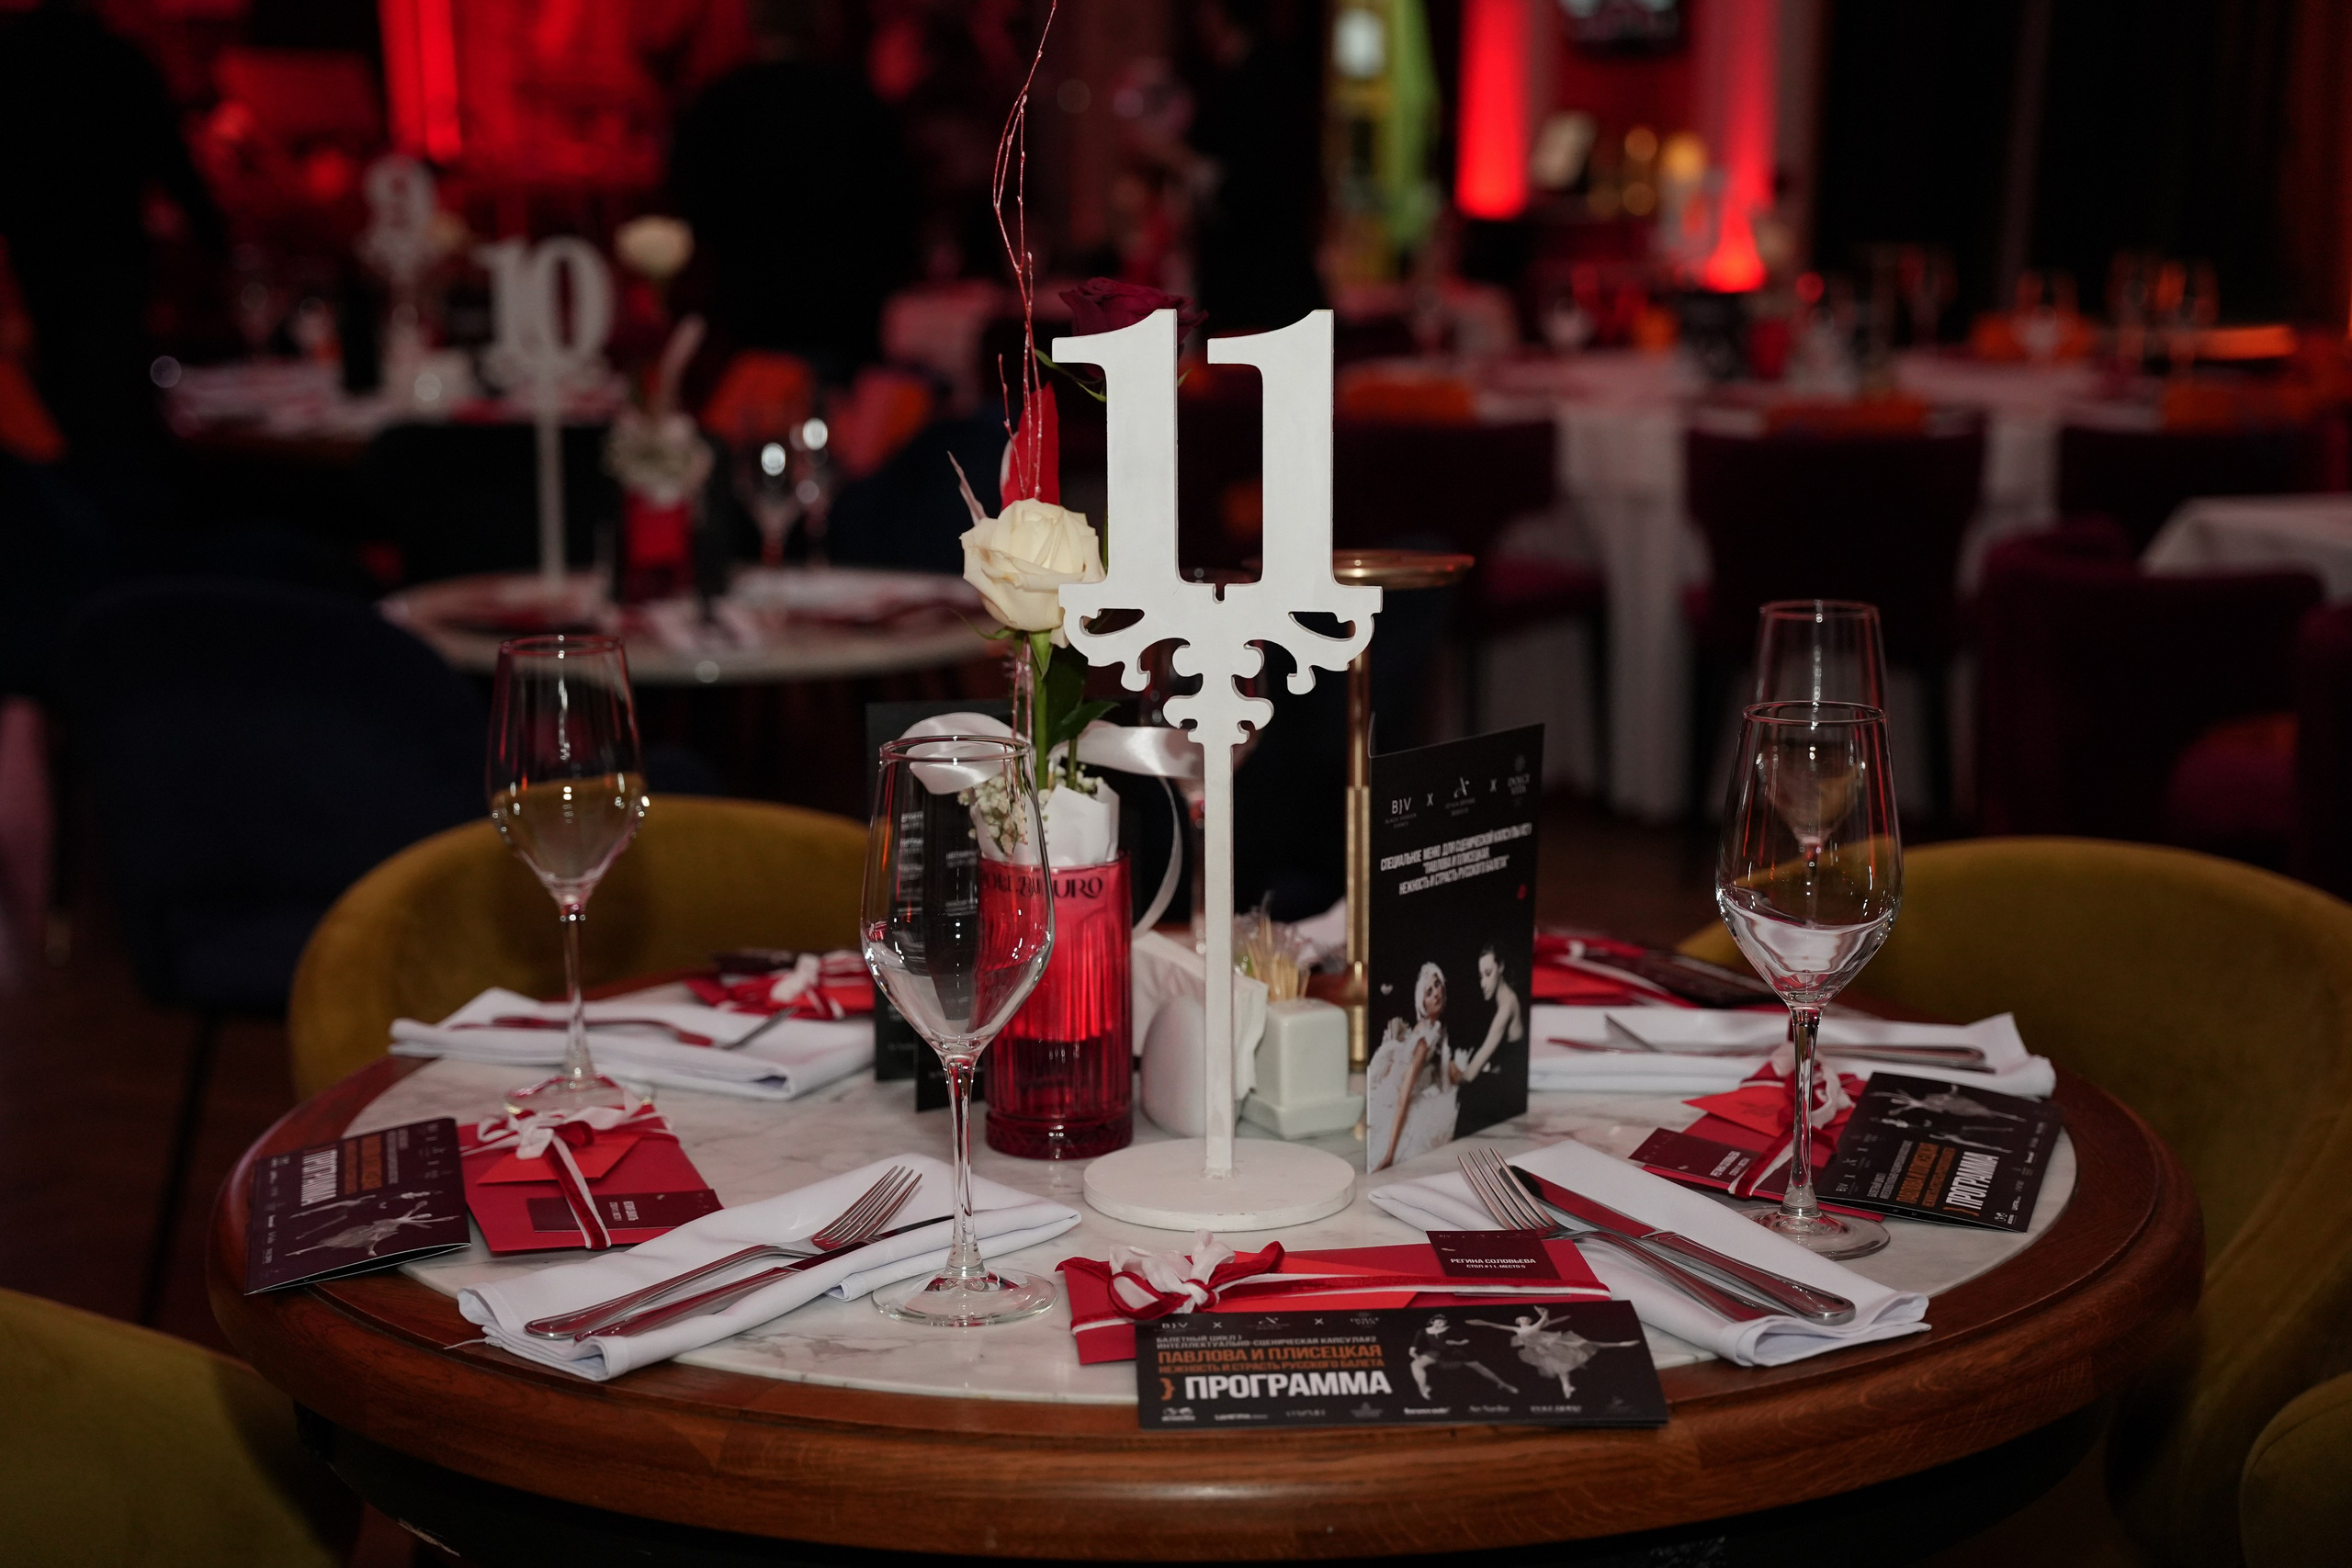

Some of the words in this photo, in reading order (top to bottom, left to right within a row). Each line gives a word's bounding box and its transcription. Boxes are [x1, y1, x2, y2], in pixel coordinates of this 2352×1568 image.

[476, 235, 616, 369] 10
[1052, 309, 1383, 614] 11
[1945, 1151, 1999, 1210] ПРОГРАММА
[1158, 1349, 1246, 1364] ПАВЛОВА
[1250, 1348, 1264, 1360] И
[1269, 1344, 1383, 1361] ПЛИСЕЦКАЯ
[1185, 1371, 1393, 1401] ПРОГРАММА
